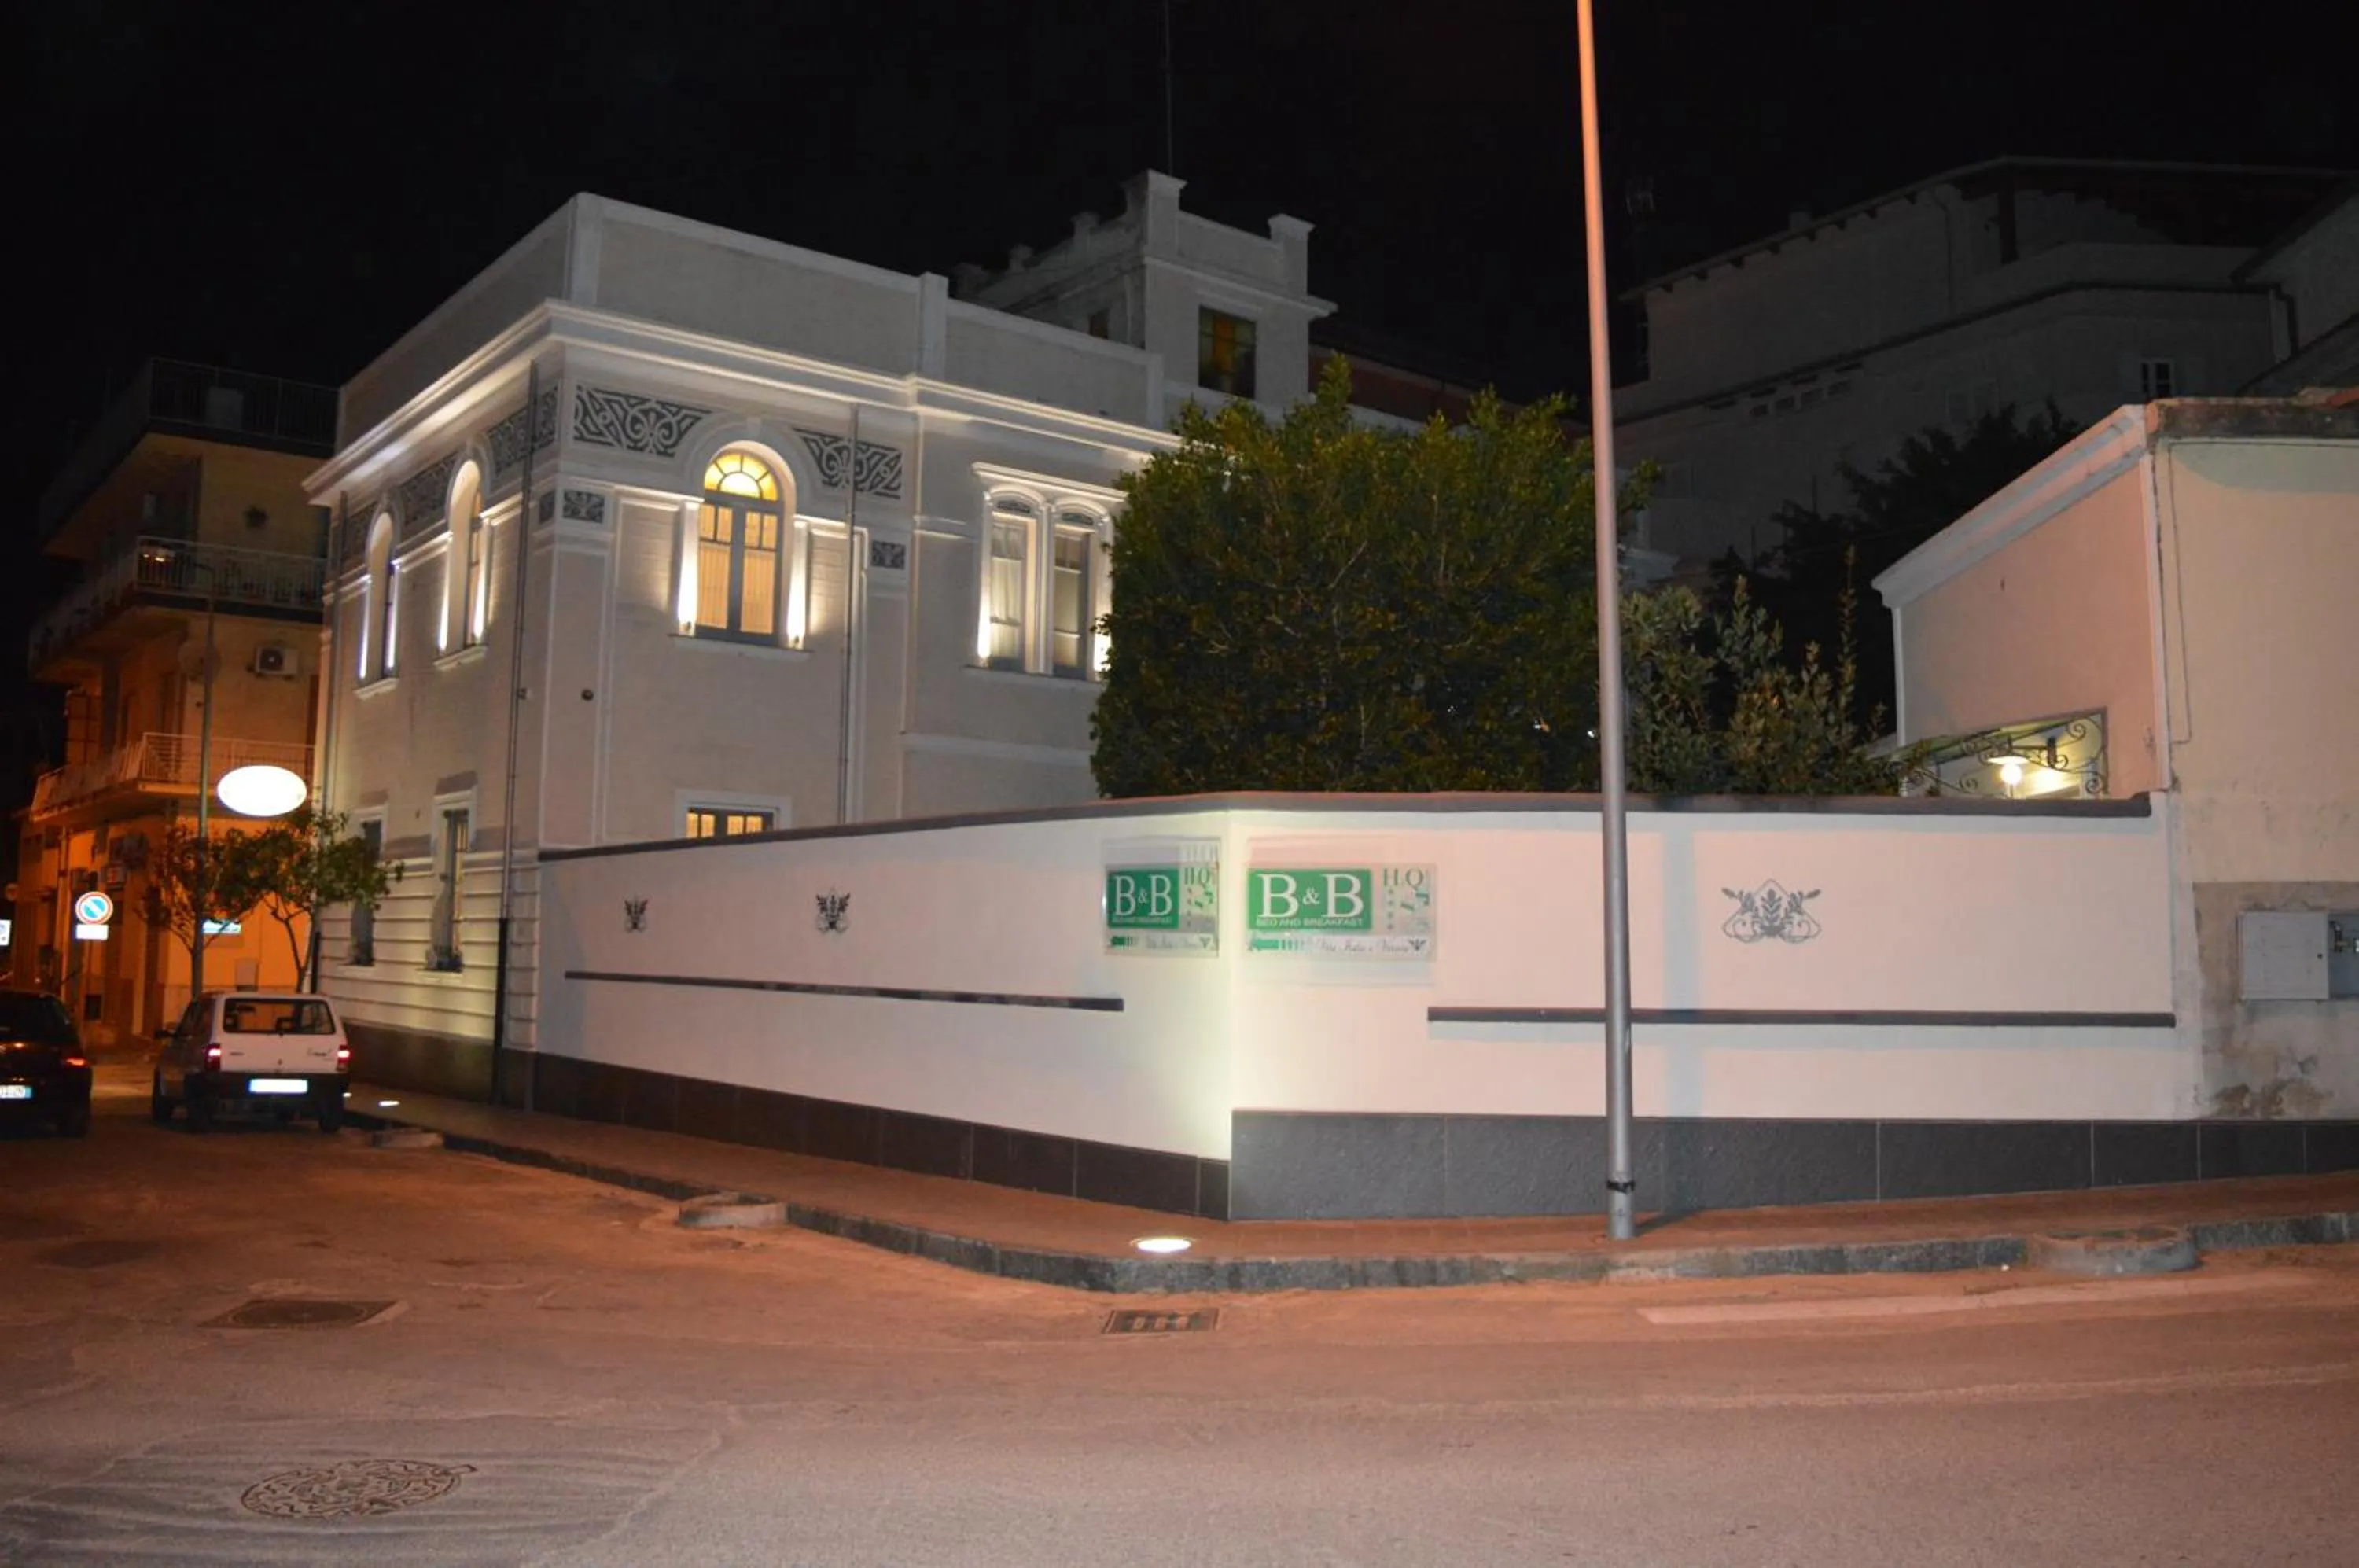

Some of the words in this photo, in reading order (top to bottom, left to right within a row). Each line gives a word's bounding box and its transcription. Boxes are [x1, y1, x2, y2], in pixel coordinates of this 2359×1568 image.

[1113, 874, 1173, 917] B&B
[1256, 873, 1364, 918] B&B
[1256, 918, 1278, 927] BED
[1279, 918, 1301, 927] AND
[1303, 918, 1363, 927] BREAKFAST
